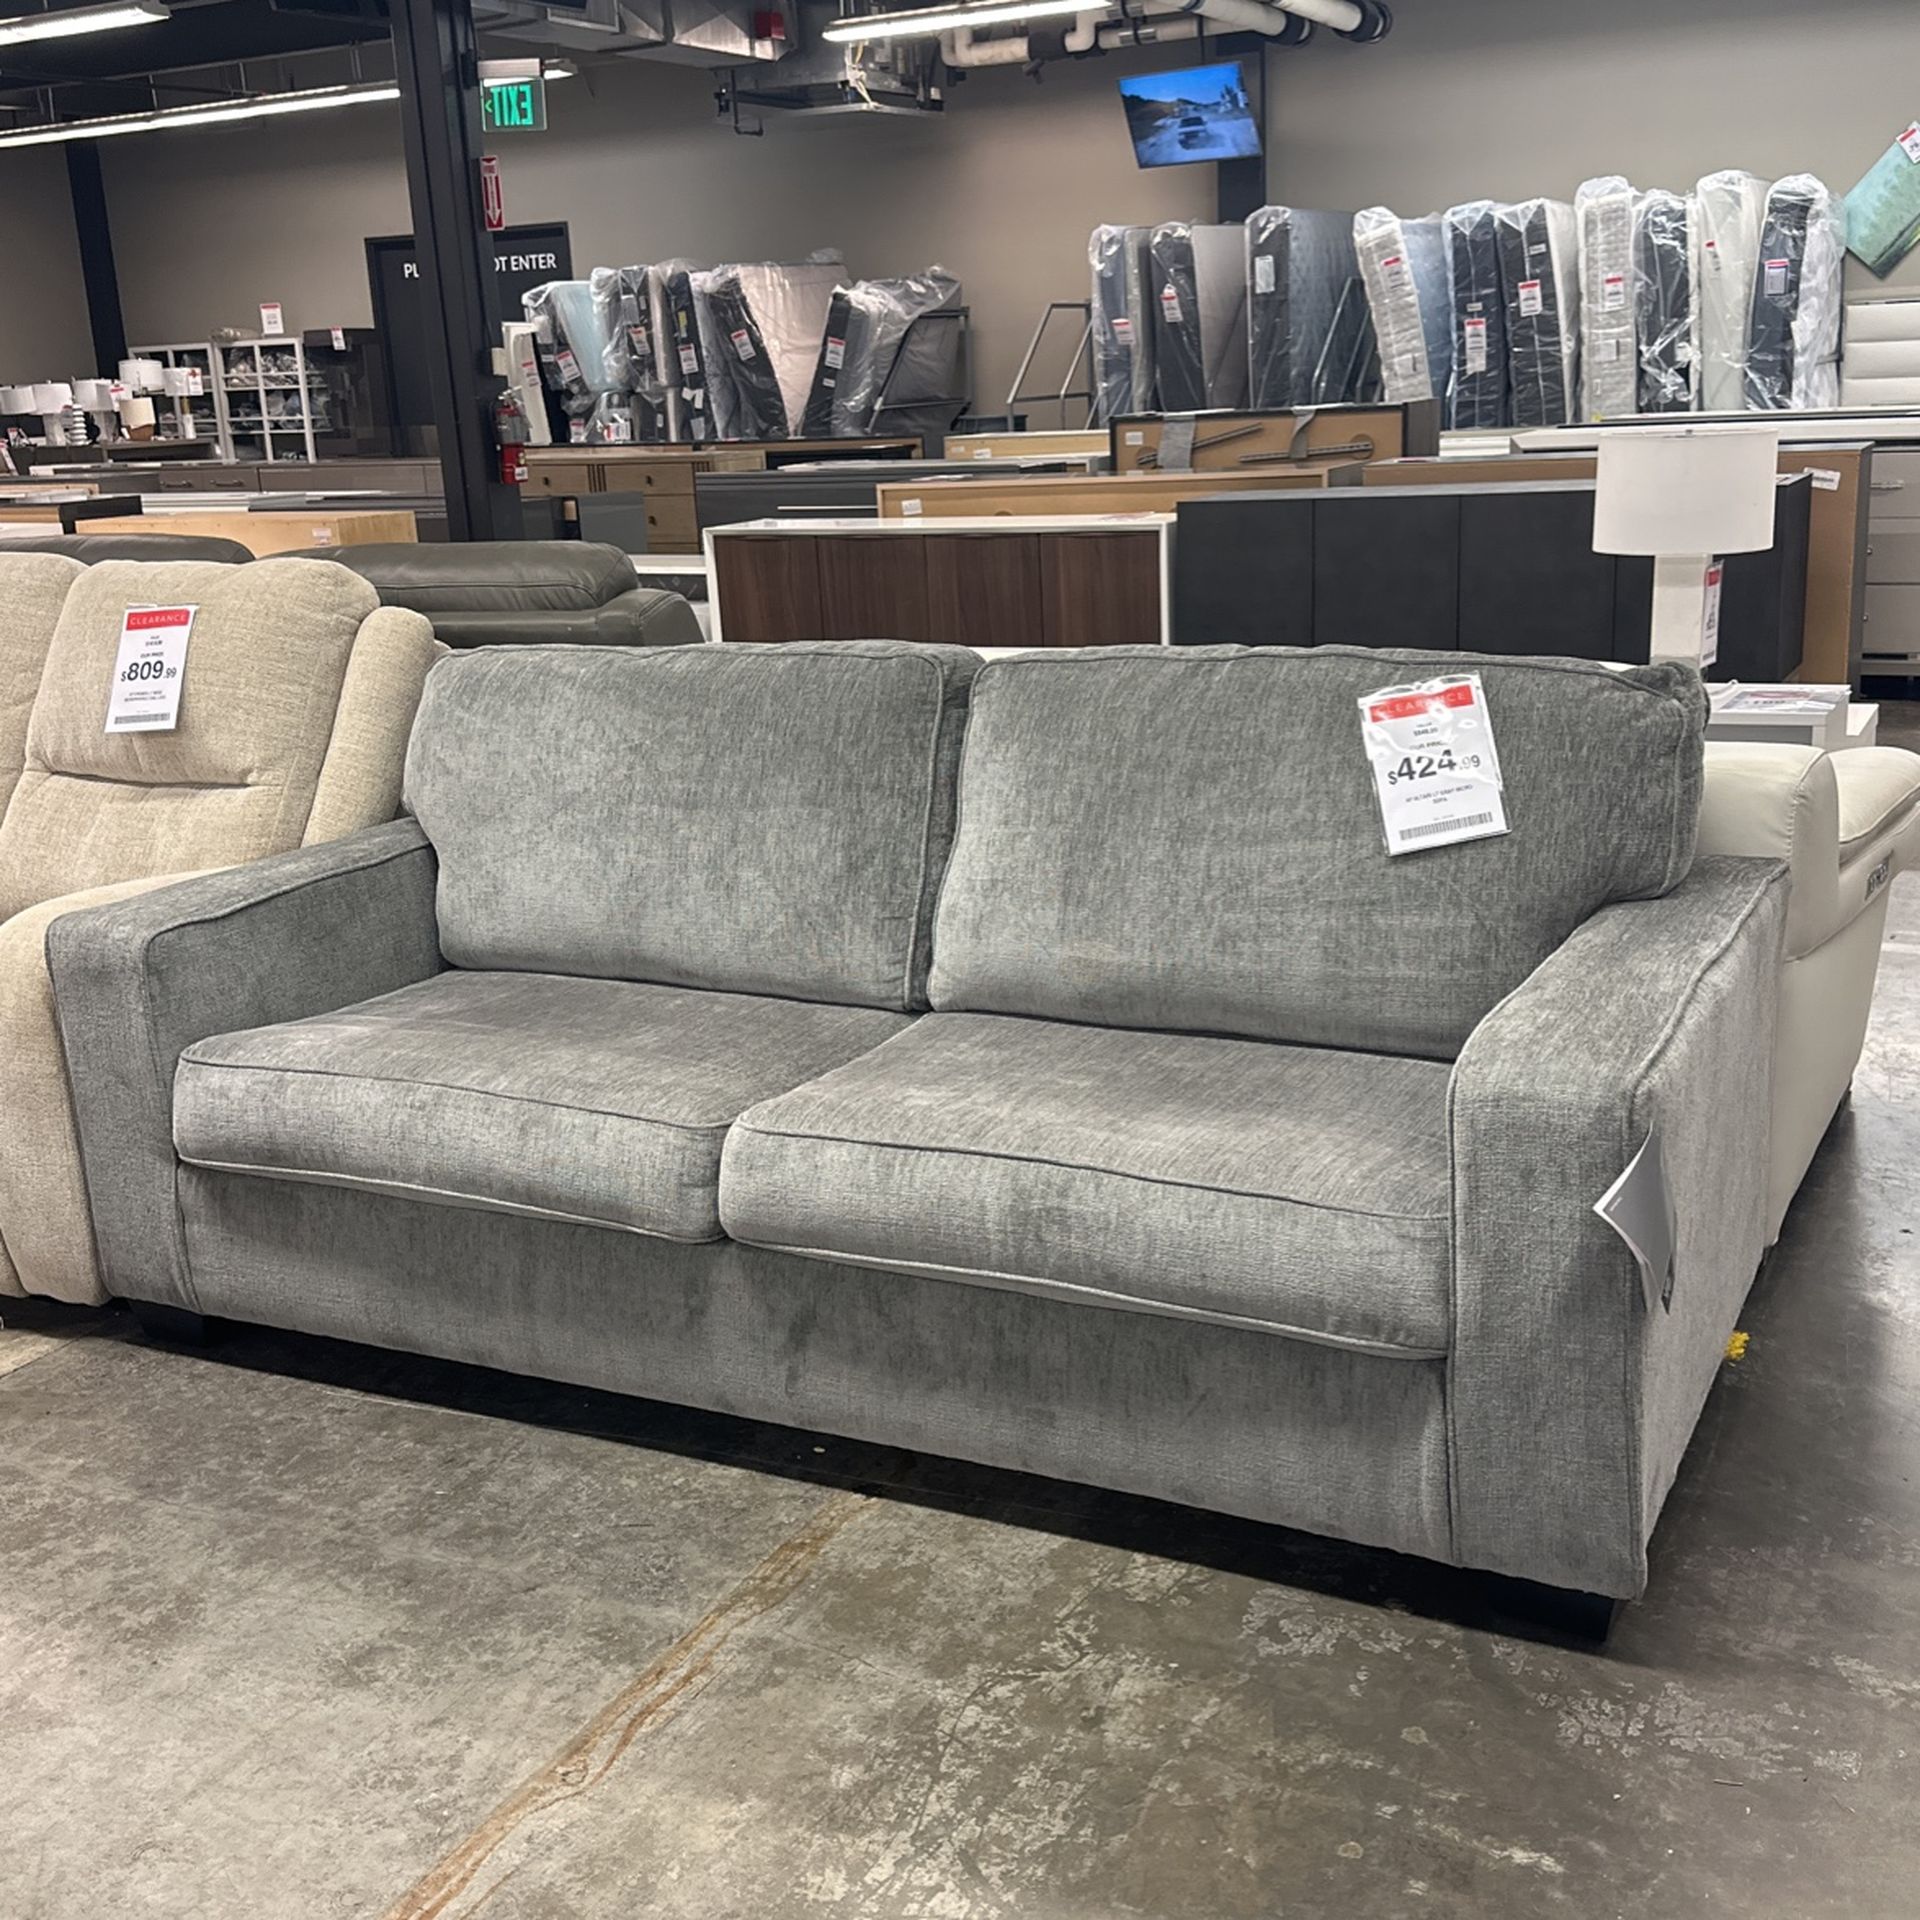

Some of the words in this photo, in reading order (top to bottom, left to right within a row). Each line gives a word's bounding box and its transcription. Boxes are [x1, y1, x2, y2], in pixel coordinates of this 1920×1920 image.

[511, 253, 557, 271] ENTER
[129, 614, 186, 625] CLEARANCE
[120, 660, 177, 682] $809.99
[1387, 749, 1481, 785] $424.99
